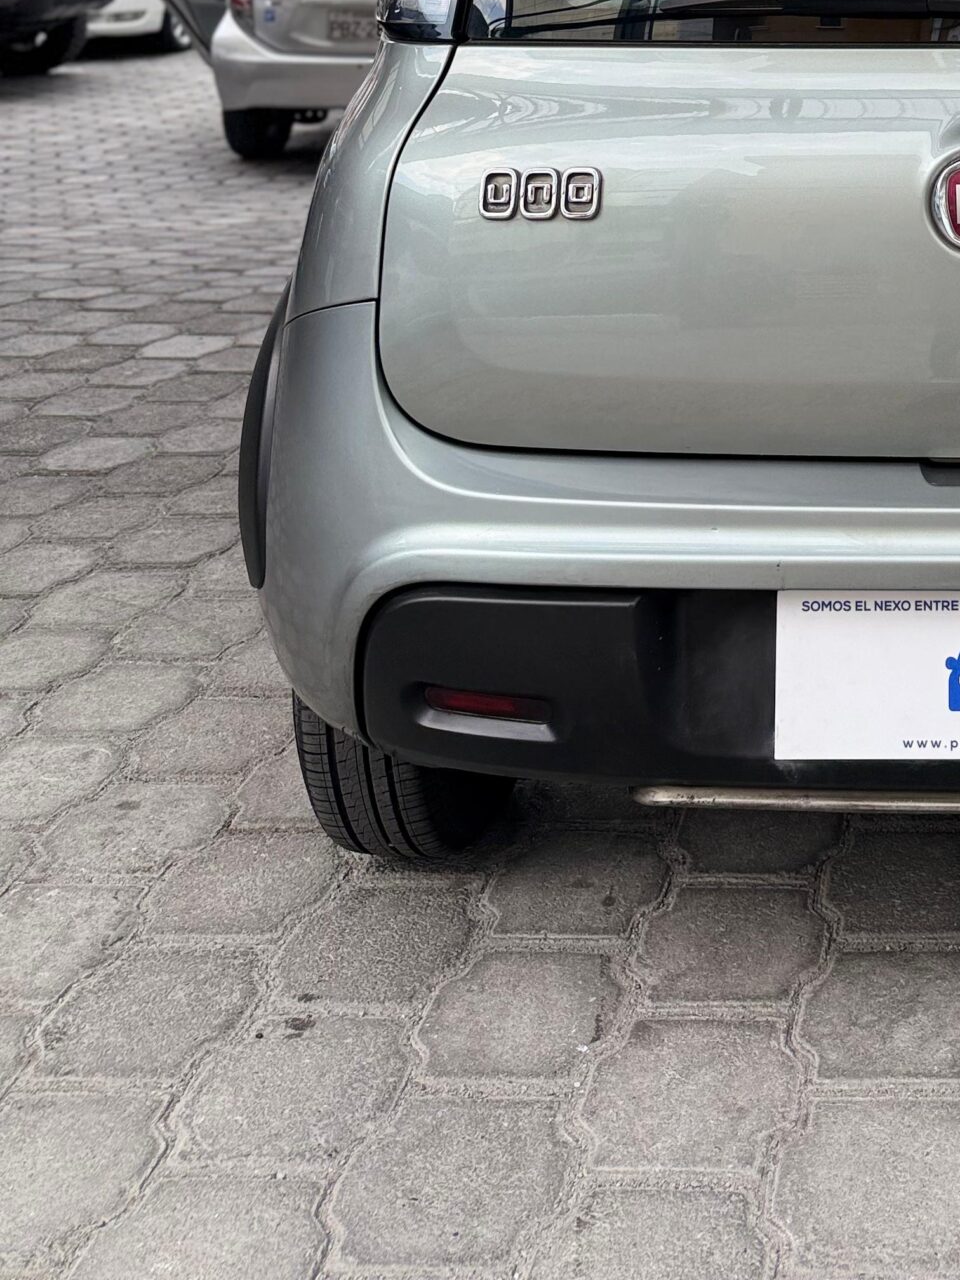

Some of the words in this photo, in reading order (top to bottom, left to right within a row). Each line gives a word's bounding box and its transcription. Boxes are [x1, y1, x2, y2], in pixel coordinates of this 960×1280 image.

[801, 600, 851, 612] SOMOS
[855, 600, 871, 612] EL
[874, 600, 911, 612] NEXO
[915, 600, 958, 612] ENTRE
